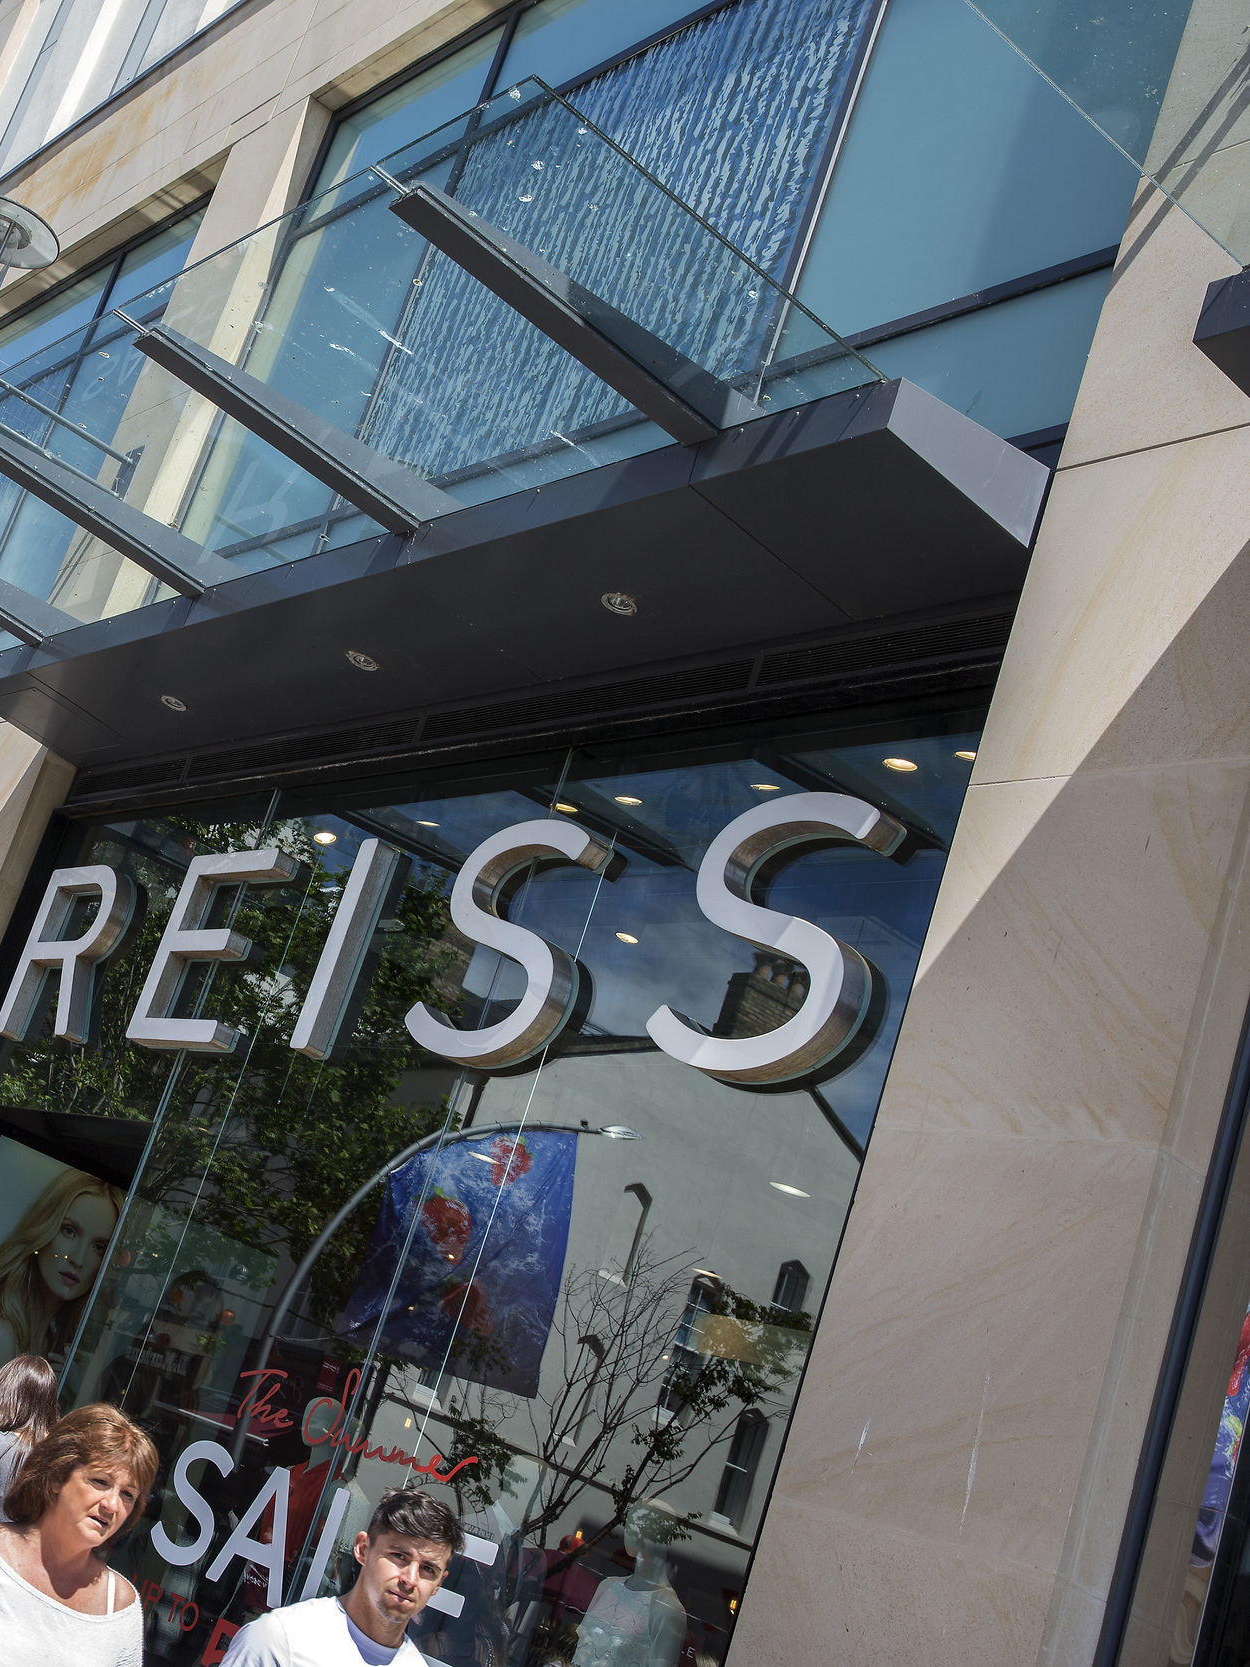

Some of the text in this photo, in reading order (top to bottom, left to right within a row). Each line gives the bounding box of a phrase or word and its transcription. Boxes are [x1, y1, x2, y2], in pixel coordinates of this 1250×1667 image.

[240, 1368, 479, 1482] The Summer
[168, 1592, 199, 1631] TO
